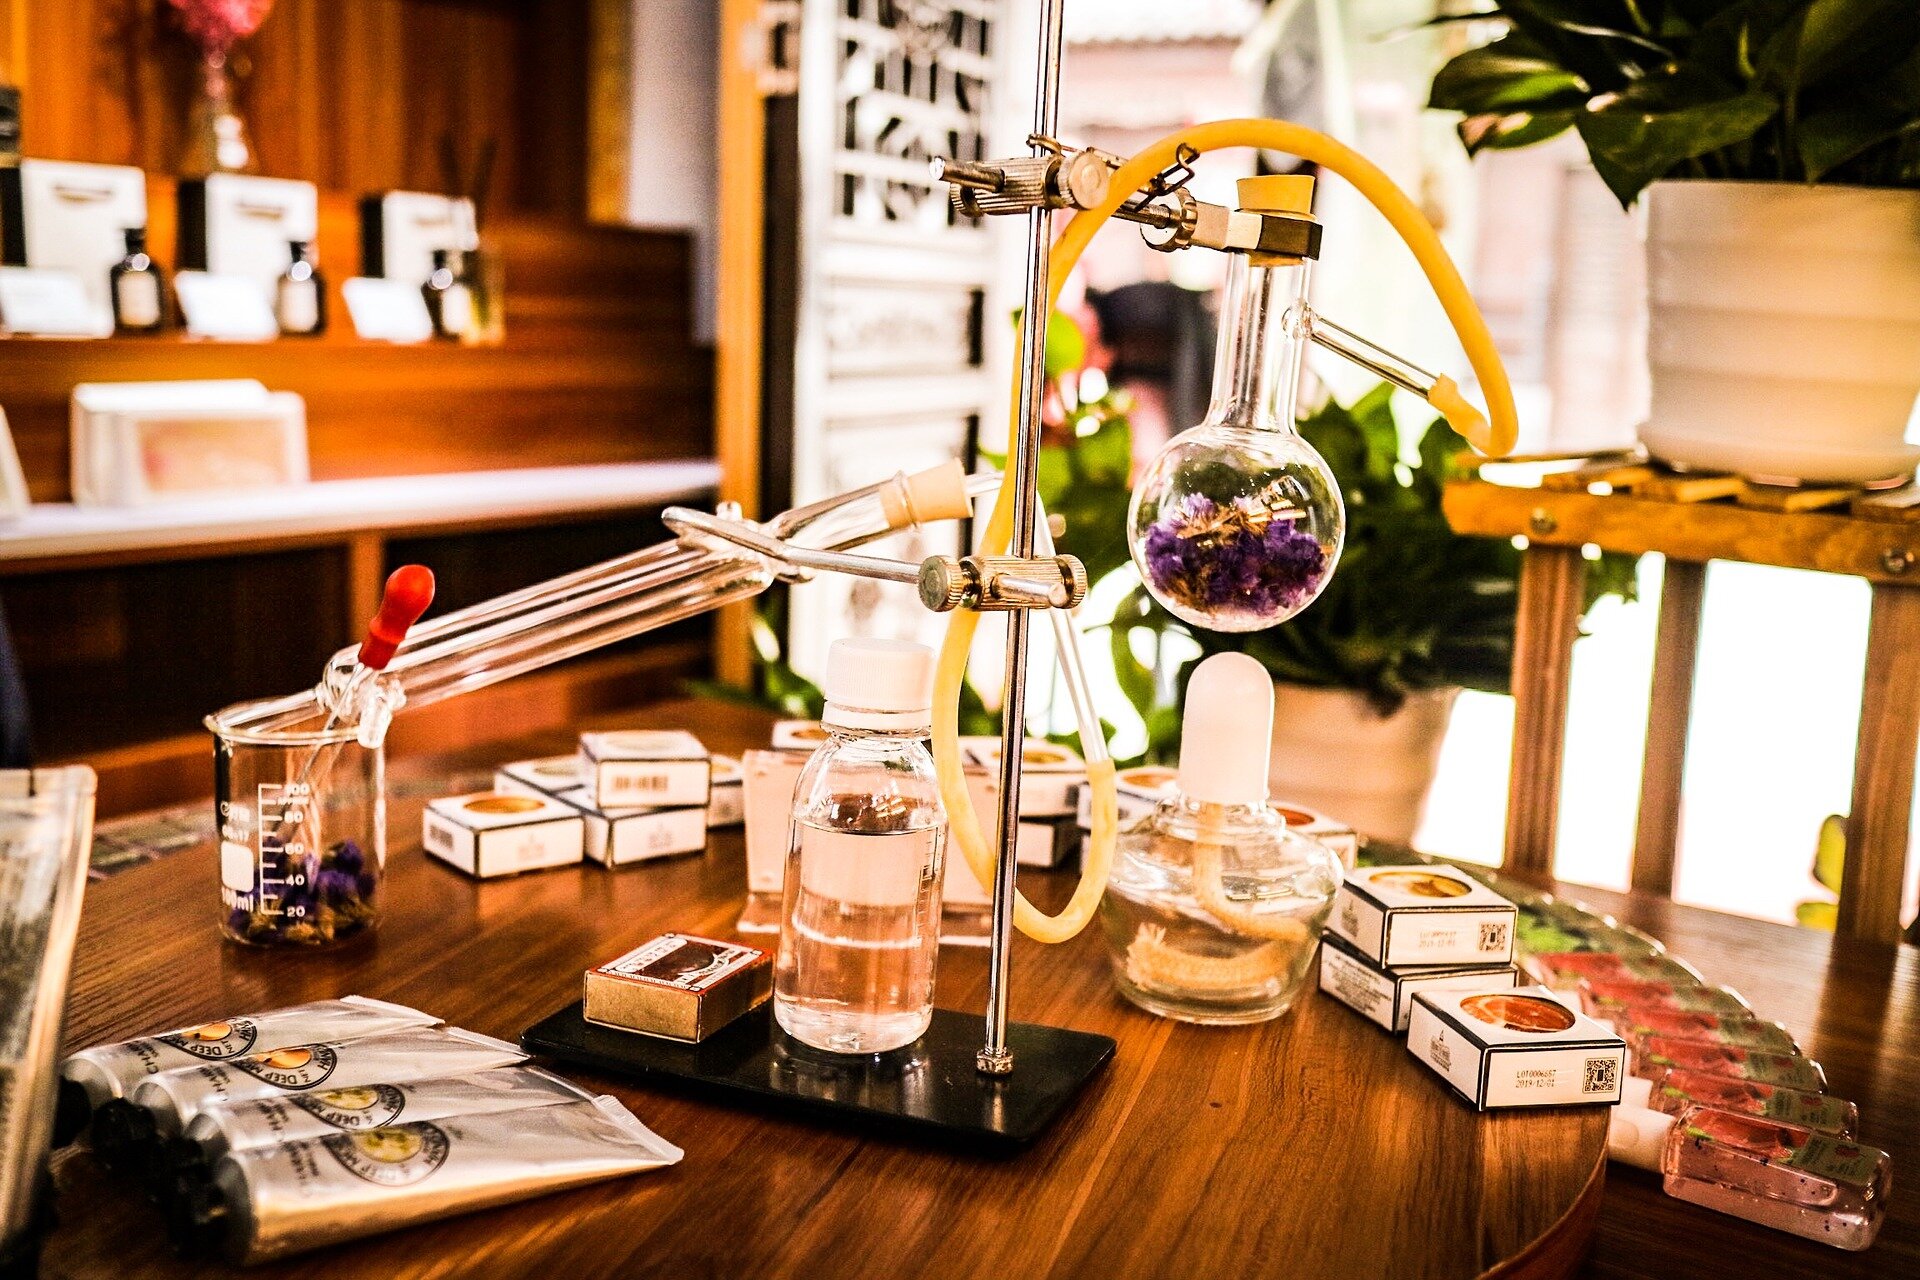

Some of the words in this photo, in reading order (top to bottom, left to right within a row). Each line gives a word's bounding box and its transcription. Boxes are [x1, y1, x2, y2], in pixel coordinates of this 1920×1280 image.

[286, 874, 305, 886] 40
[287, 906, 306, 918] 20
[190, 1045, 223, 1056] DEEP
[265, 1071, 298, 1085] DEEP
